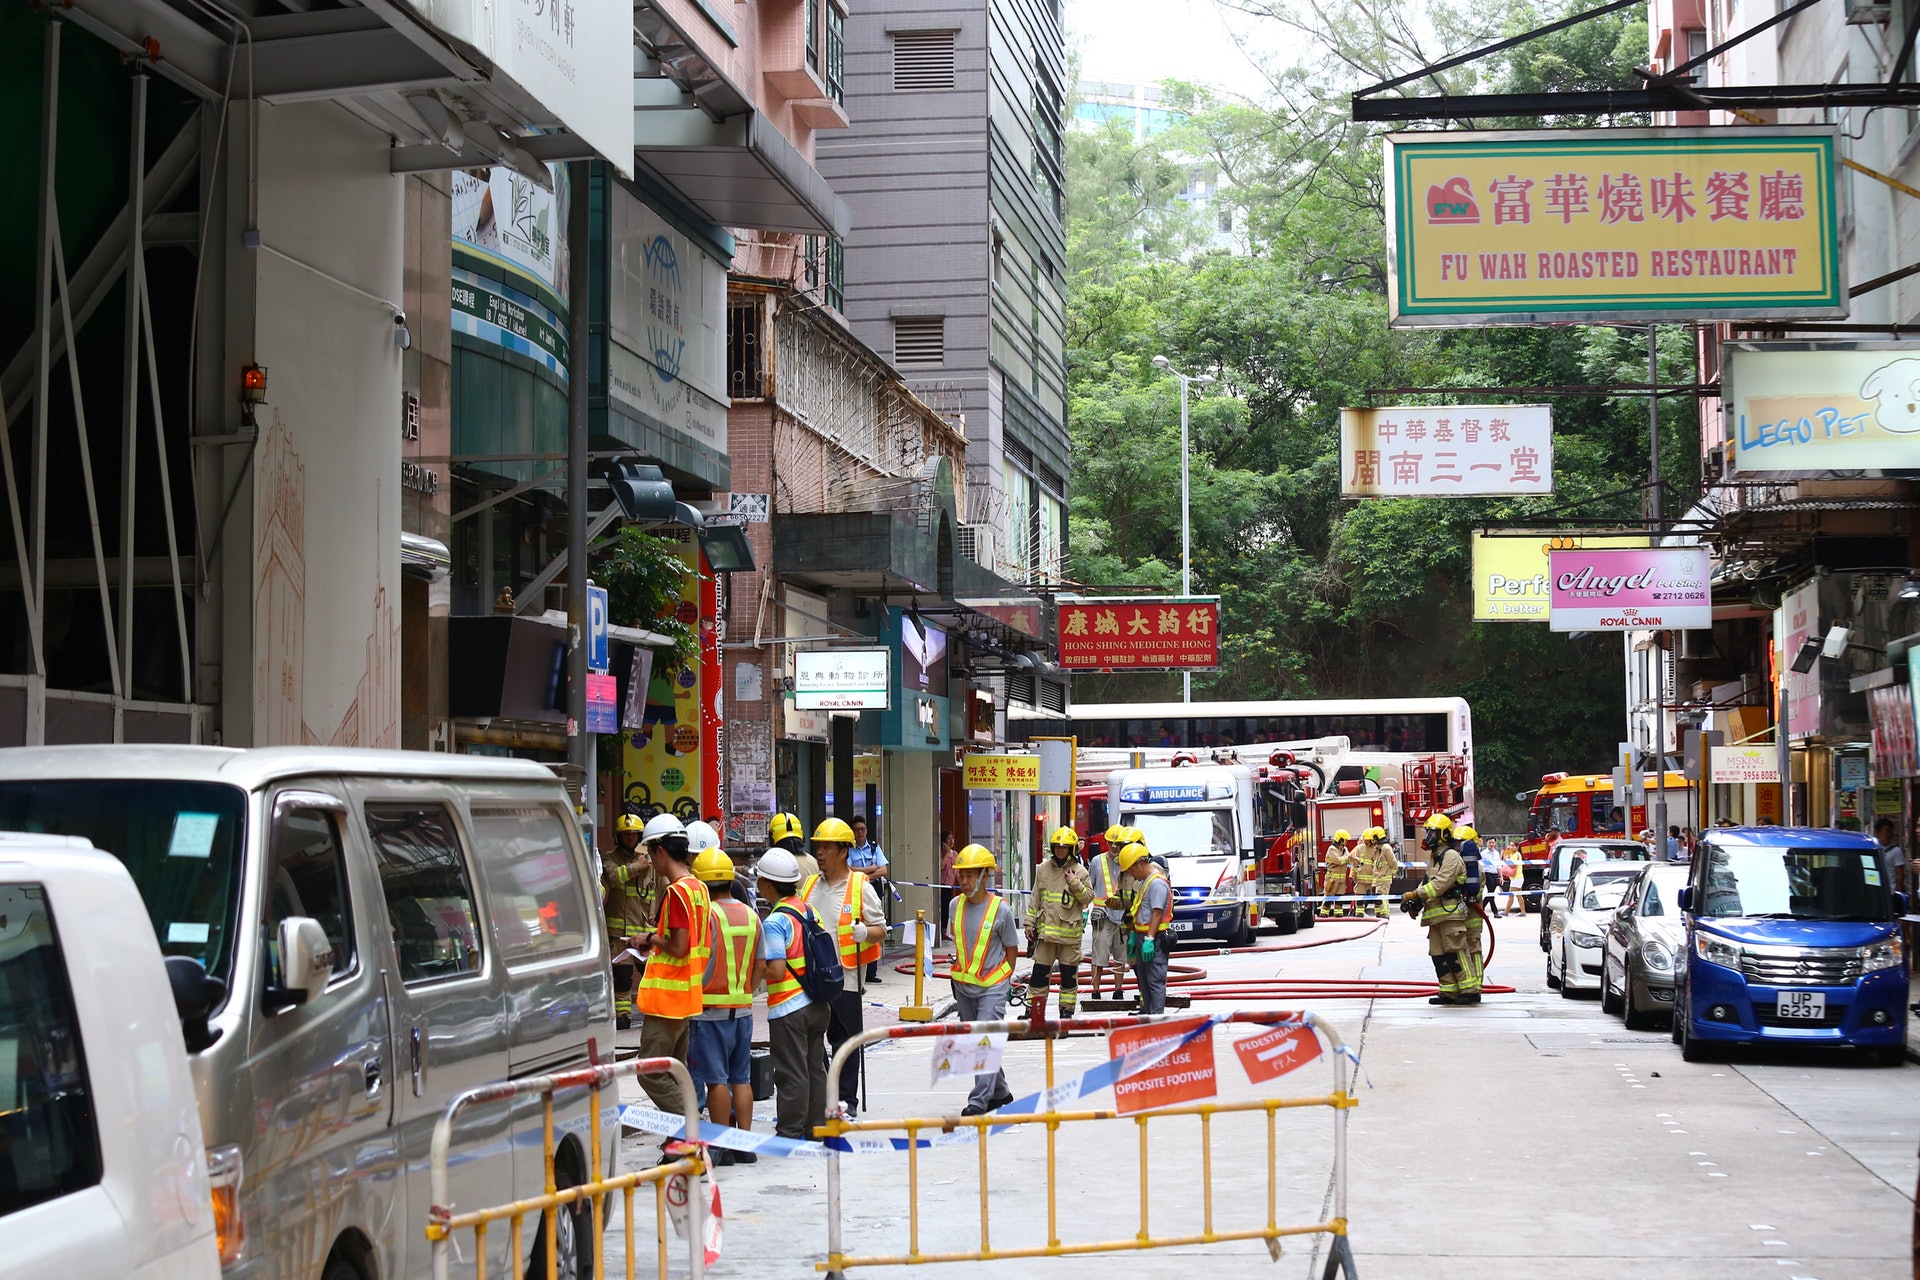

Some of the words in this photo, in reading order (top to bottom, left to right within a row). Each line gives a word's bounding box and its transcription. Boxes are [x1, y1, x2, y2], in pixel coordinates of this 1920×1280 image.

[1488, 169, 1806, 225] 富華燒味餐廳
[1441, 254, 1469, 281] FU
[1479, 253, 1527, 280] WAH
[1538, 251, 1639, 279] ROASTED
[1651, 248, 1797, 277] RESTAURANT
[1377, 418, 1511, 444] 中華基督教
[1740, 414, 1813, 451] LEGO
[1815, 408, 1870, 437] PET
[1351, 446, 1542, 486] 閩南三一堂
[1557, 566, 1657, 596] Angel
[1656, 579, 1675, 588] Pet
[1677, 579, 1704, 589] Shop
[1663, 592, 1683, 600] 2712
[1488, 604, 1498, 614] A
[1503, 603, 1544, 614] better
[590, 596, 604, 660] P
[1600, 618, 1630, 627] ROYAL
[1632, 617, 1662, 626] CANIN
[1065, 641, 1094, 650] HONG
[1096, 641, 1127, 649] SHING
[1129, 640, 1180, 649] MEDICINE
[1182, 640, 1211, 649] HONG
[1064, 655, 1097, 664] 政府註冊
[799, 671, 885, 680] 恩典動物診所
[968, 766, 998, 777] 何景文
[1743, 771, 1759, 780] 3956
[1761, 771, 1777, 779] 8082
[1150, 788, 1203, 799] AMBULANCE
[1791, 993, 1812, 1005] UP
[1780, 1004, 1822, 1018] 6237
[1172, 1052, 1191, 1064] USE
[1272, 1055, 1297, 1071] 行人
[1116, 1076, 1165, 1095] OPPOSITE
[1166, 1067, 1214, 1086] FOOTWAY
